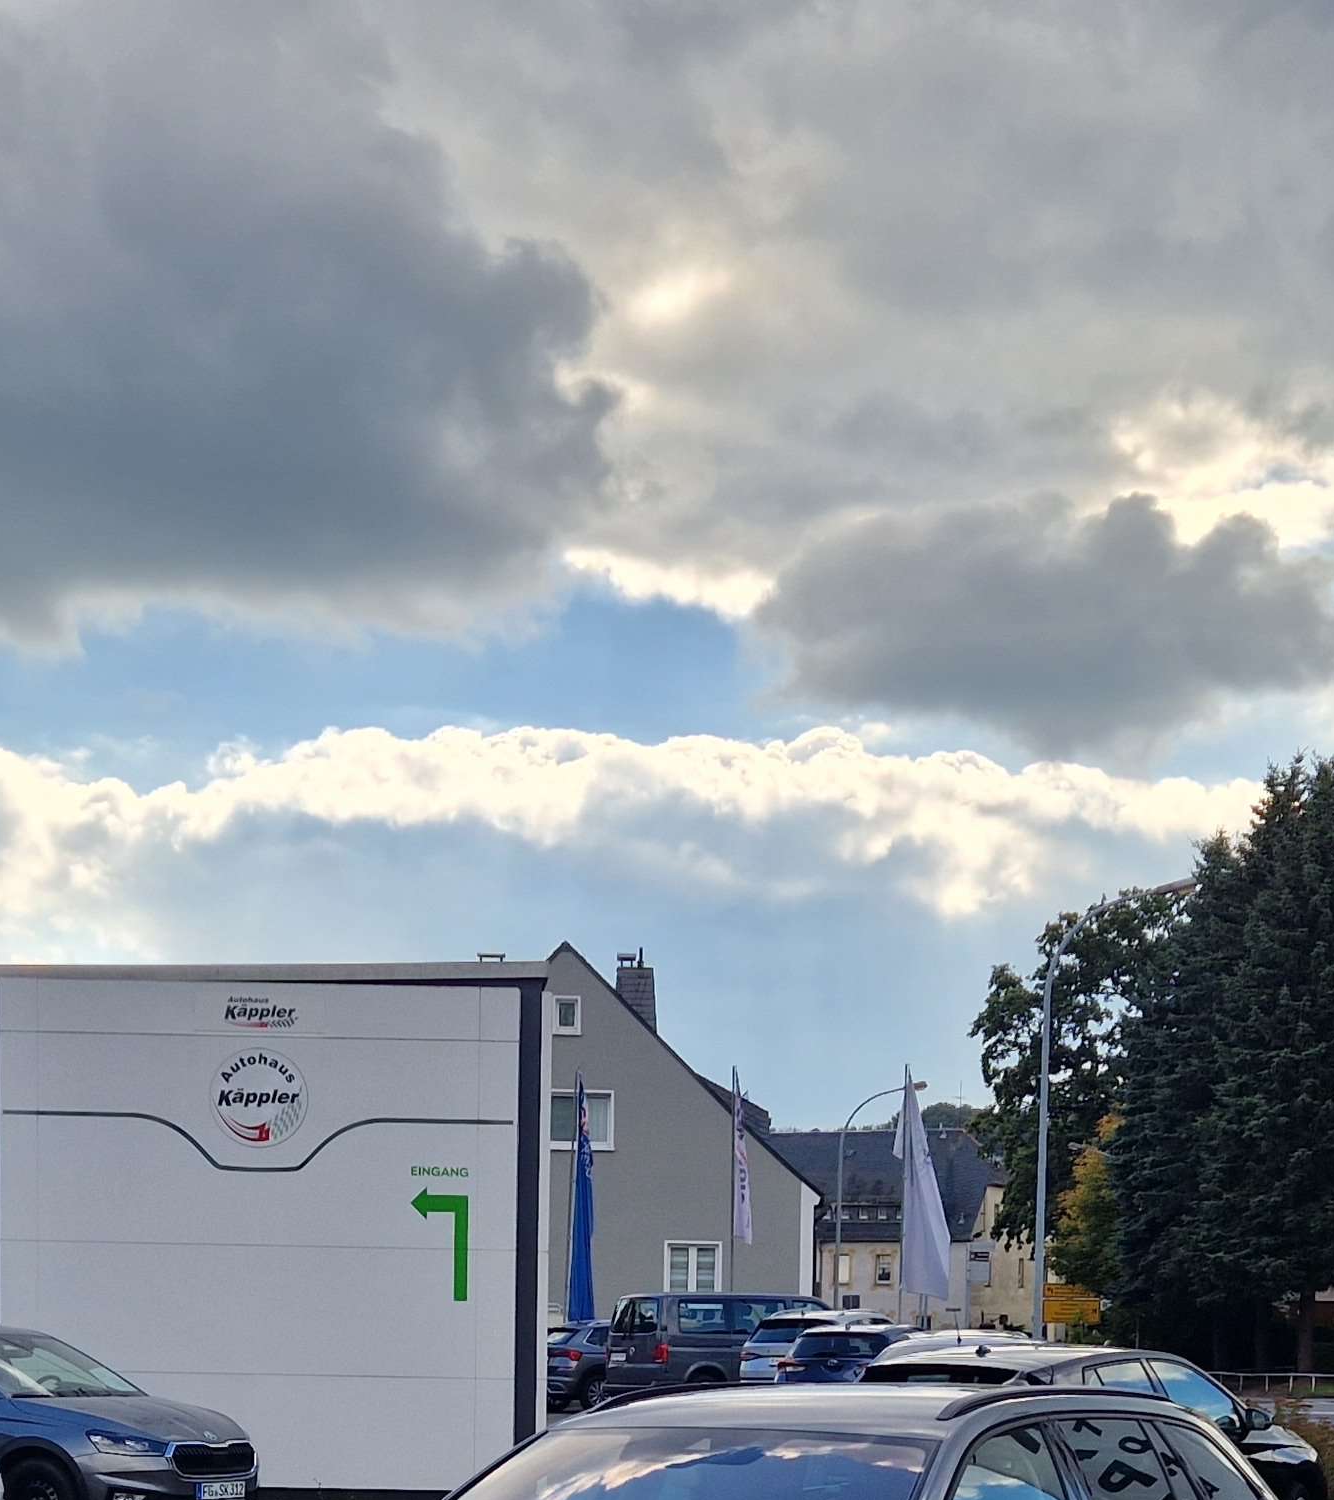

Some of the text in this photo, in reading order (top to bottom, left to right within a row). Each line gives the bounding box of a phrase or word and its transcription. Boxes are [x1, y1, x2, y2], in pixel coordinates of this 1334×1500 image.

[224, 1004, 296, 1021] Käppler
[220, 1053, 296, 1084] Autohaus
[218, 1088, 300, 1107] Käppler
[411, 1166, 469, 1177] EINGANG
[203, 1485, 214, 1496] FG
